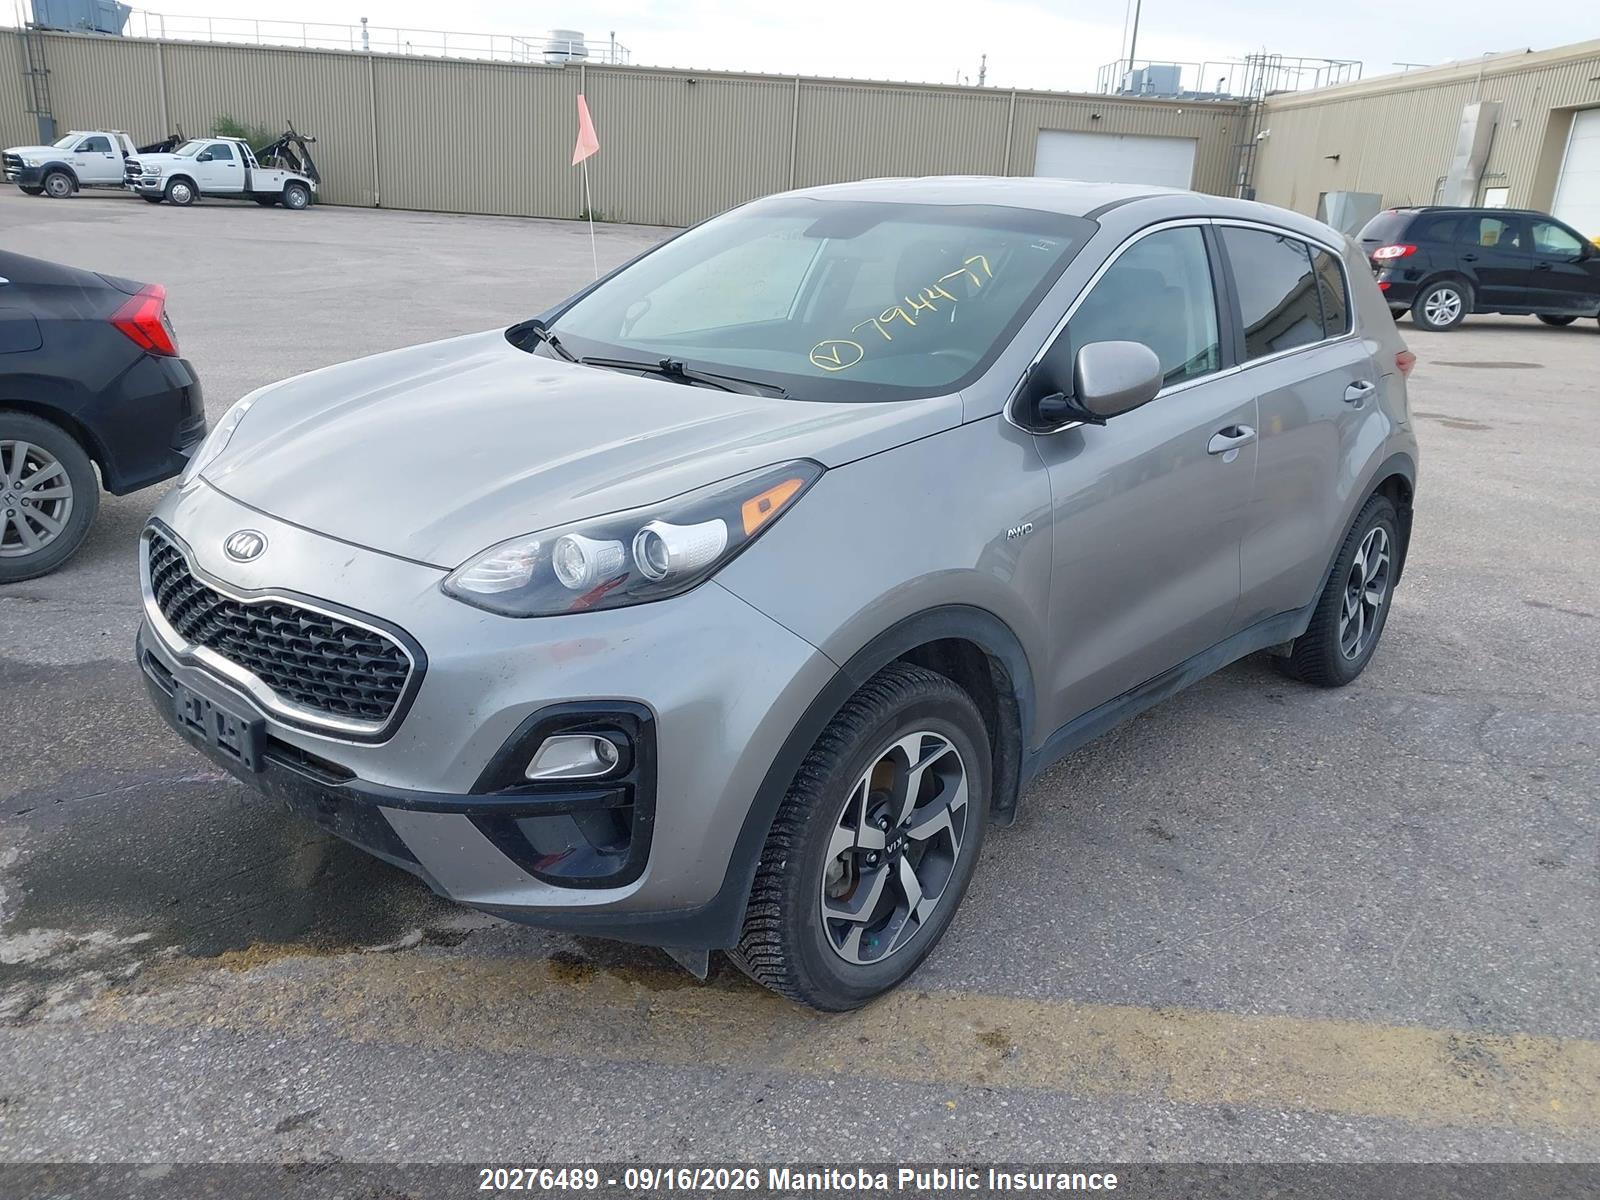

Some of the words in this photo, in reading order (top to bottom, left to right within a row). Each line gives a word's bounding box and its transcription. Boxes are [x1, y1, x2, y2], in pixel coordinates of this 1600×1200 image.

[851, 254, 993, 341] 794477
[1006, 522, 1033, 541] AWD
[886, 836, 902, 853] KIA
